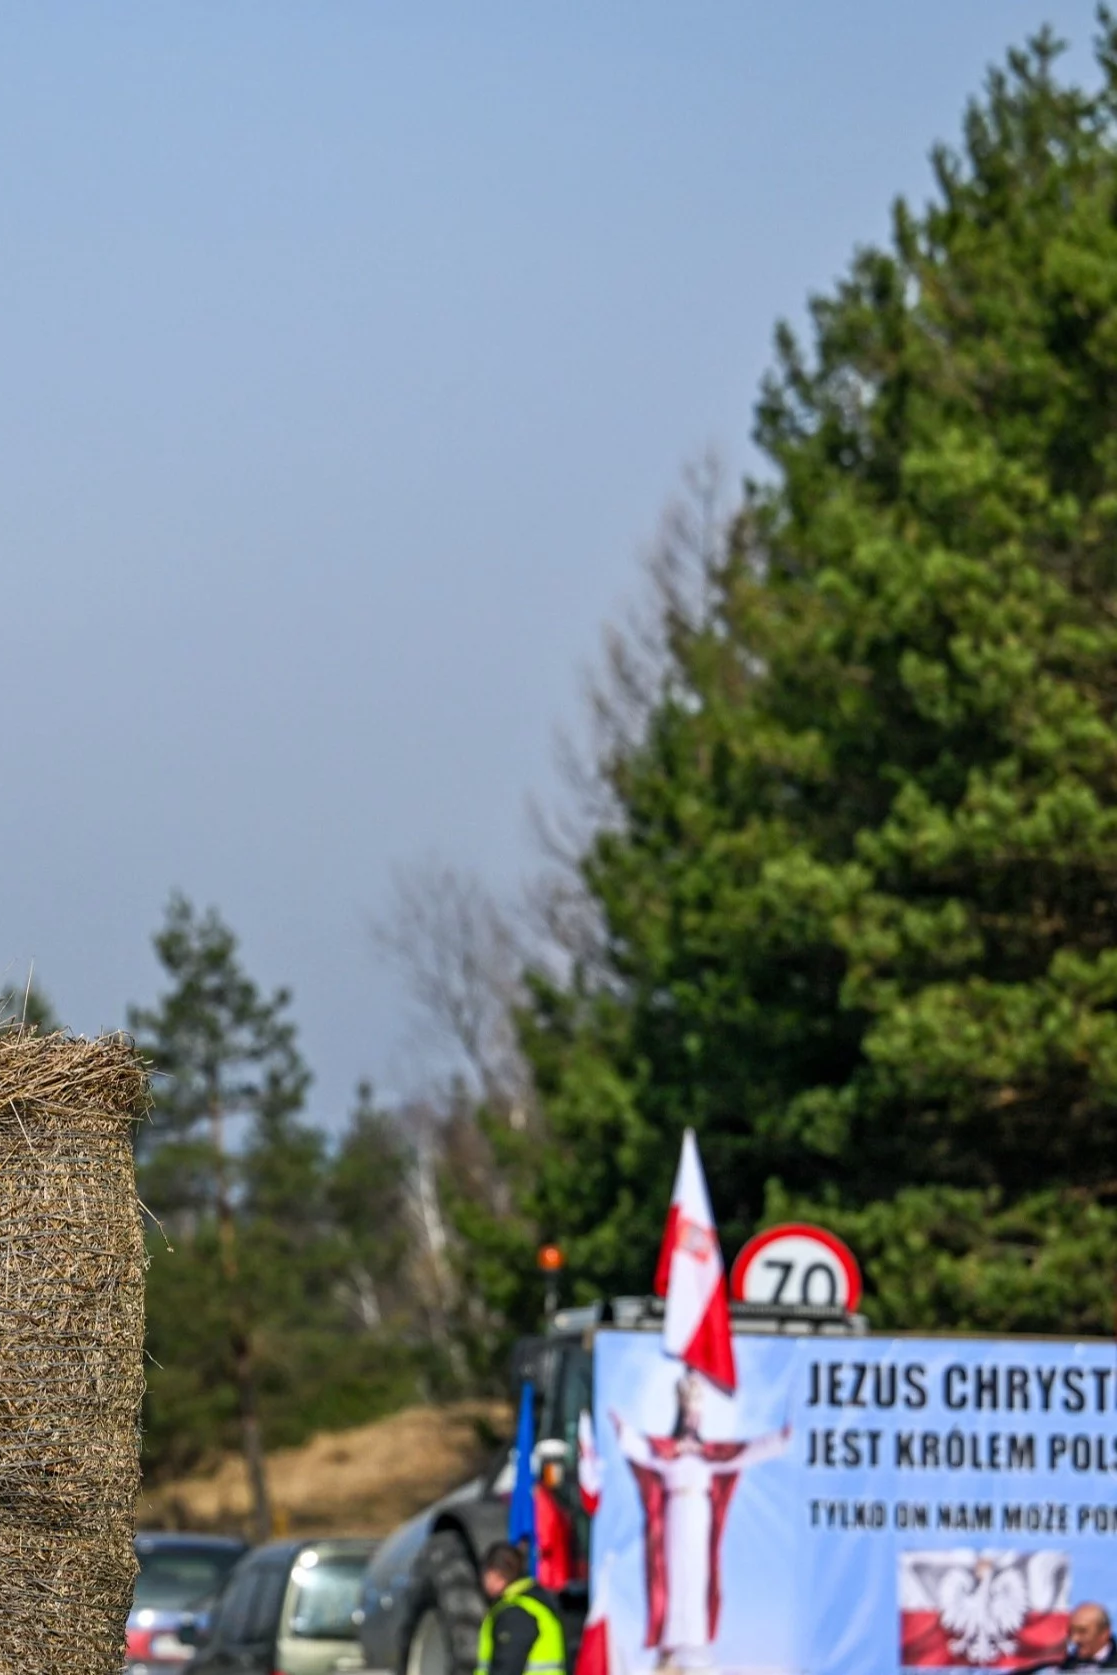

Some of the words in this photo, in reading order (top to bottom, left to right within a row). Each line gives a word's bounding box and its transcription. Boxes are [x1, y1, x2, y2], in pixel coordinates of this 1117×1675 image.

[763, 1260, 837, 1307] 70
[808, 1362, 927, 1409] JEZUS
[943, 1364, 1117, 1413] CHRYST
[808, 1429, 881, 1467] JEST
[895, 1423, 1036, 1471] KRÓLEM
[1048, 1433, 1117, 1472] POL
[810, 1500, 885, 1529] TYLKO
[895, 1501, 929, 1529] ON
[937, 1502, 992, 1531] NAM
[1002, 1500, 1069, 1533] MOŻE
